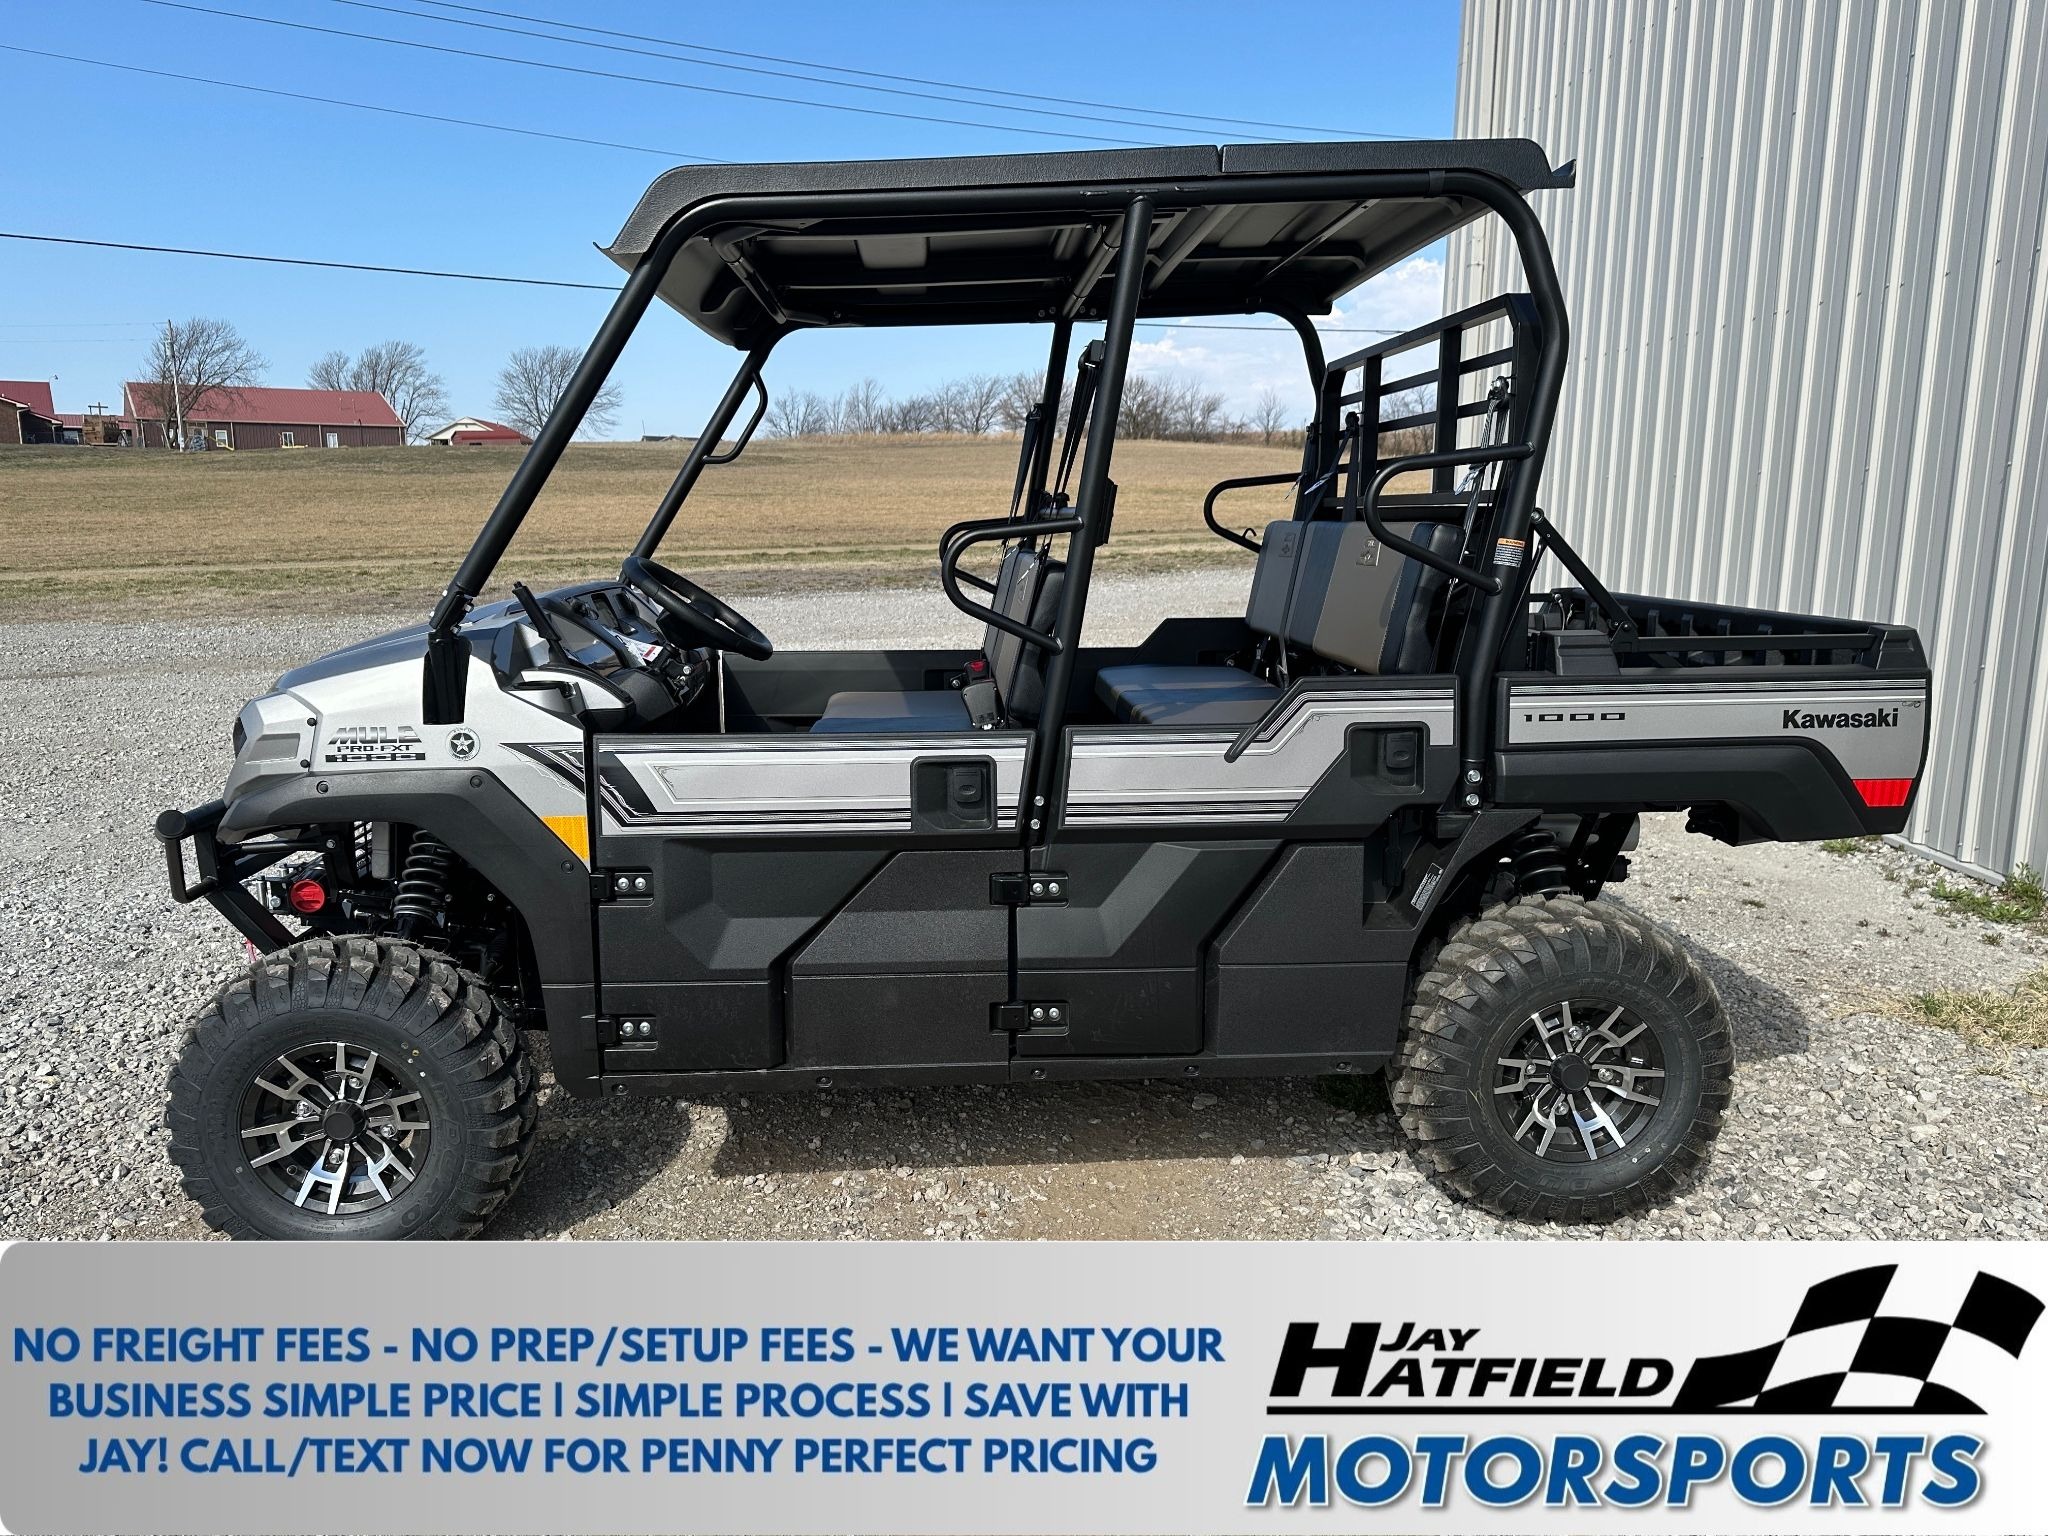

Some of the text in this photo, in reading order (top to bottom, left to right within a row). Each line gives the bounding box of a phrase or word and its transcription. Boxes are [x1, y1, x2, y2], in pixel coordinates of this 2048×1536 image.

[1524, 713, 1626, 722] 1000
[1782, 707, 1899, 730] Kawasaki
[328, 725, 422, 745] MULE
